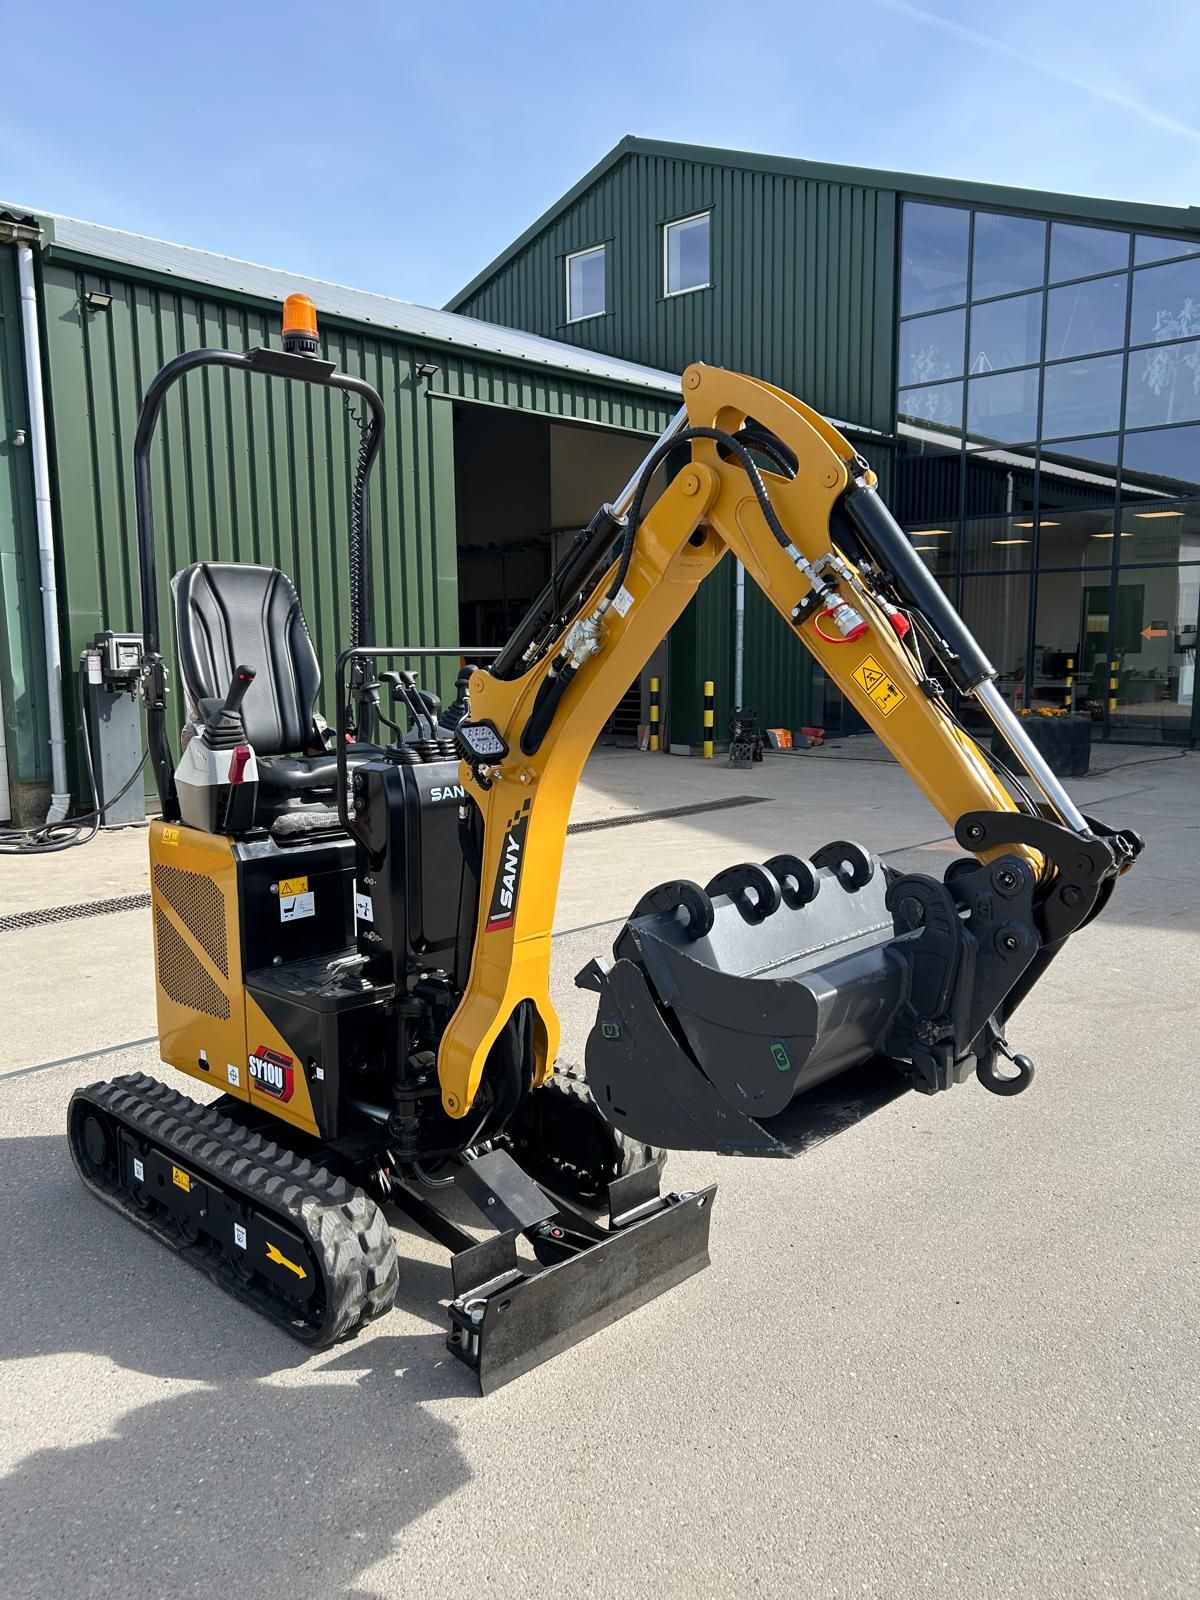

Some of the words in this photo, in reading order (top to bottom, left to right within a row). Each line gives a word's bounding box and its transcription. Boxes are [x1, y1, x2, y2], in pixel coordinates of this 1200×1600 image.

[430, 784, 465, 802] SAN
[500, 833, 520, 909] SANY
[248, 1055, 283, 1089] SY10U
